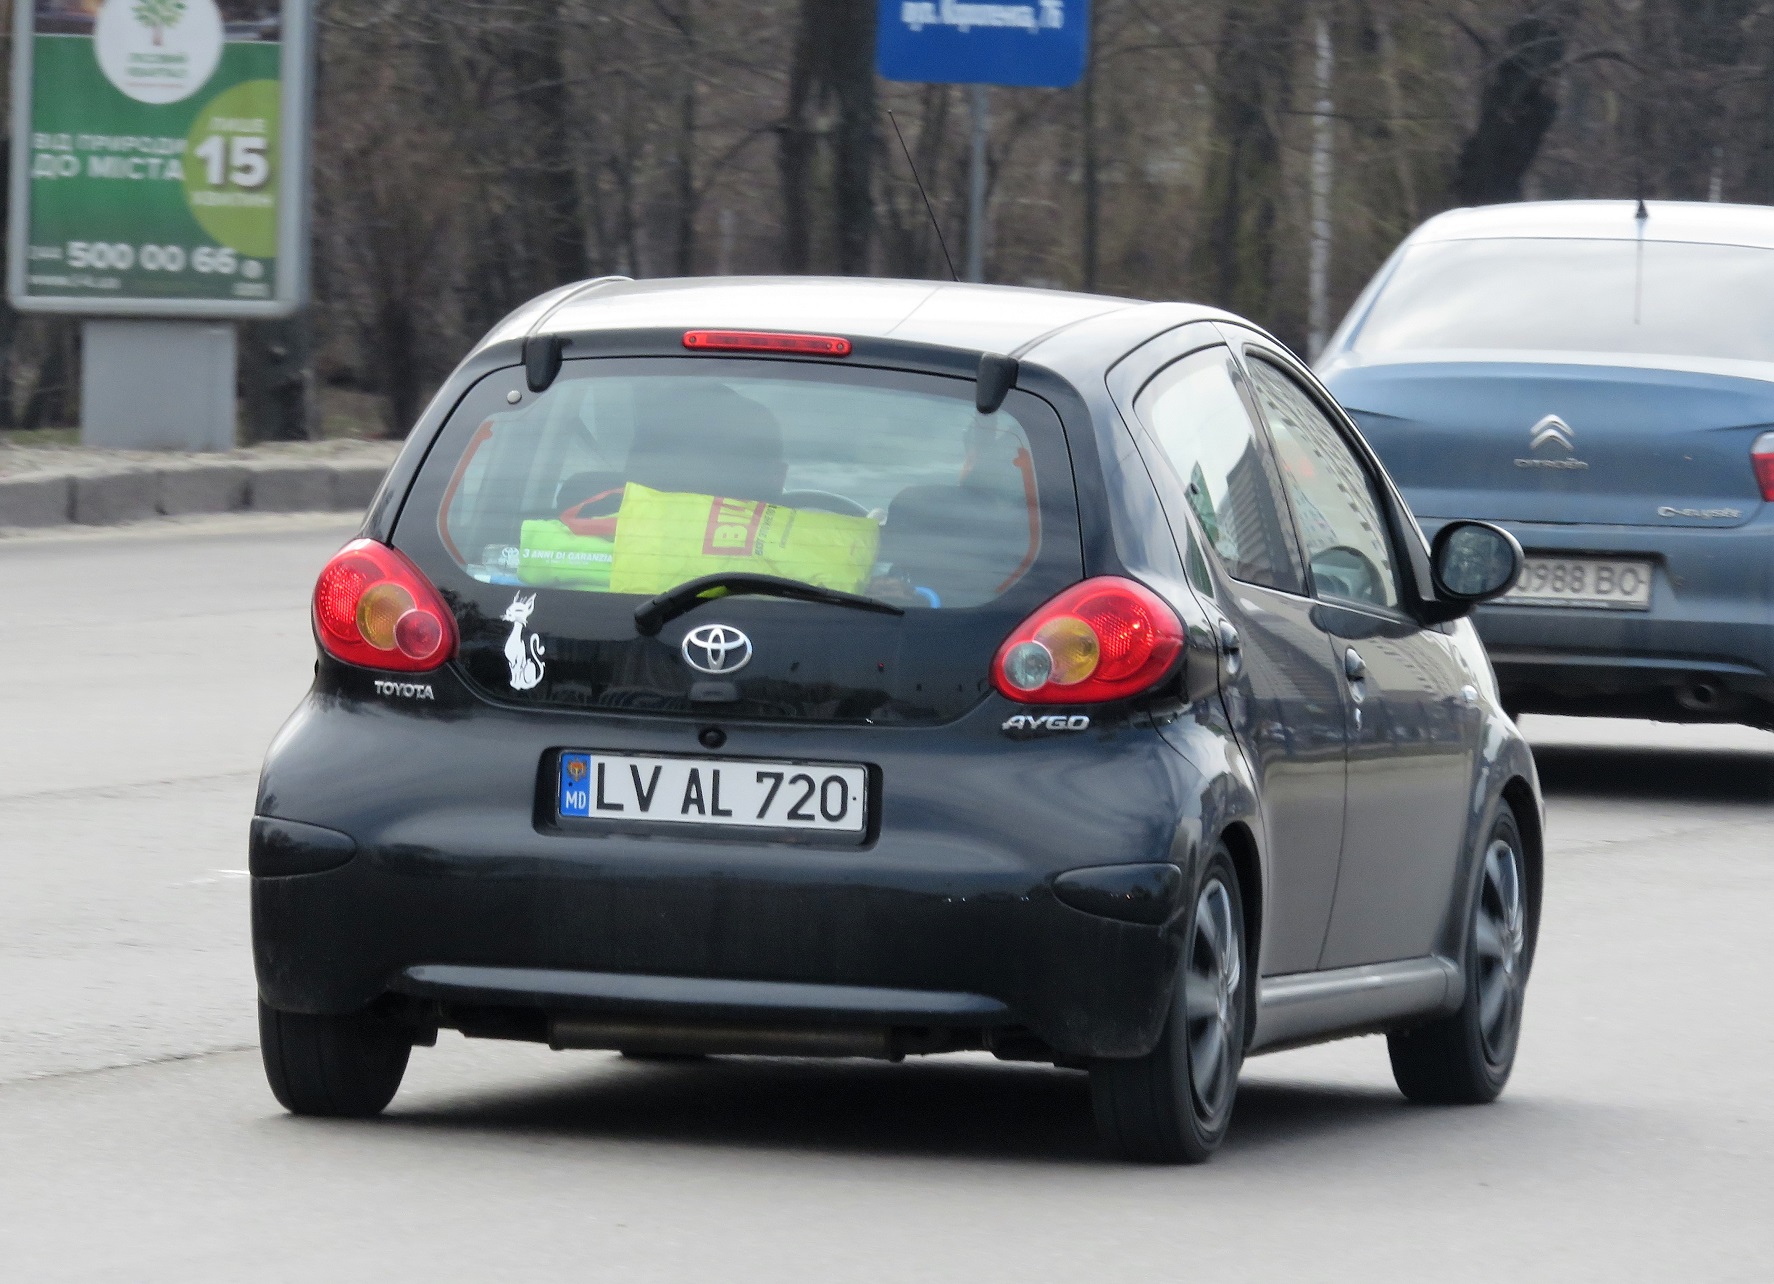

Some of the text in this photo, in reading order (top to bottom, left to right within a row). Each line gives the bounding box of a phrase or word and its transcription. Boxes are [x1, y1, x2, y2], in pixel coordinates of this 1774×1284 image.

[31, 153, 186, 181] ДО МІСТА
[194, 135, 270, 188] 15
[66, 241, 135, 270] 500
[139, 244, 188, 273] 00
[522, 548, 530, 559] 3
[531, 549, 553, 560] ANNI
[556, 551, 566, 560] DI
[568, 552, 614, 564] GARANZIA
[1597, 566, 1639, 596] BO
[374, 680, 435, 700] TOYOTA
[1001, 714, 1090, 731] AYGO
[565, 790, 587, 811] MD
[596, 762, 849, 823] LV AL 720
